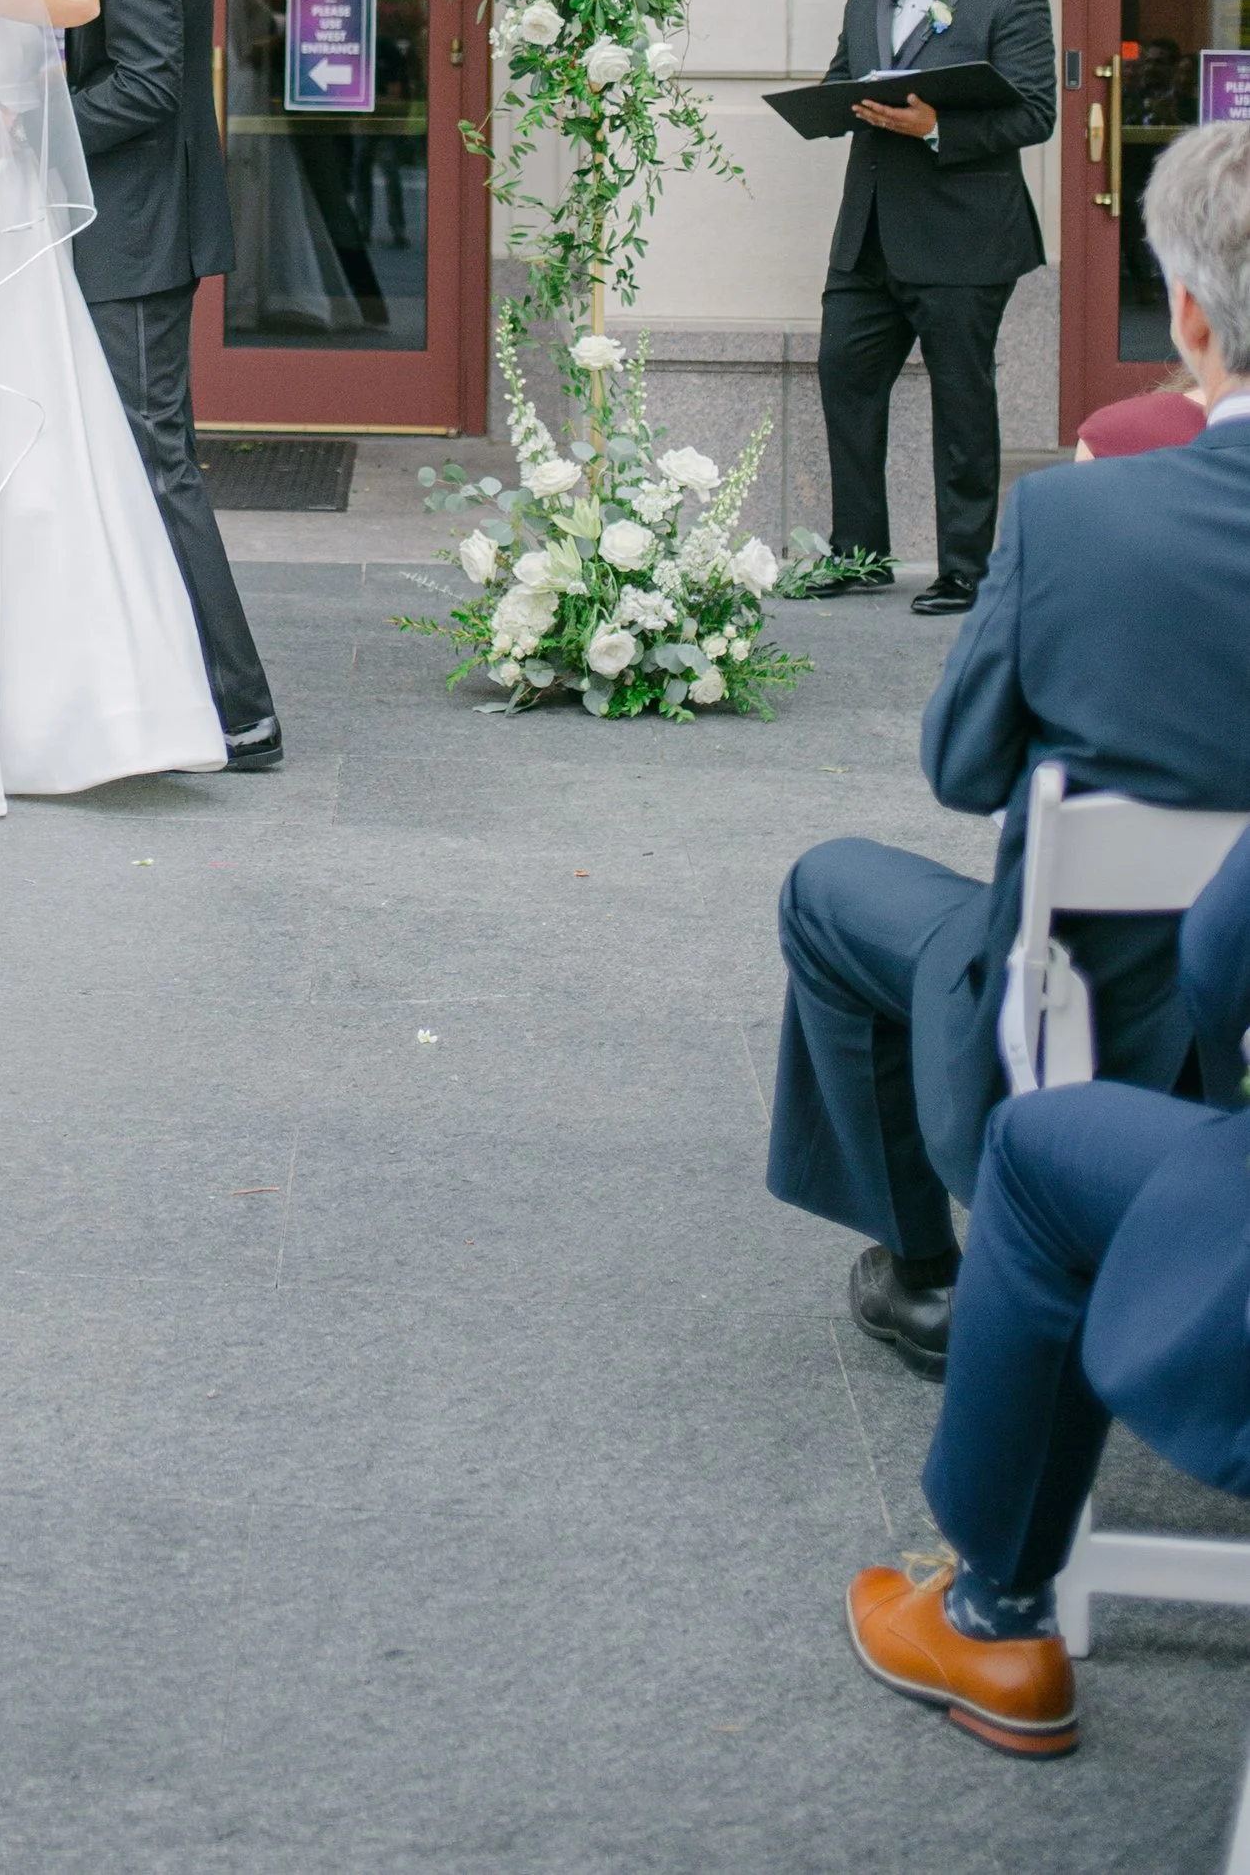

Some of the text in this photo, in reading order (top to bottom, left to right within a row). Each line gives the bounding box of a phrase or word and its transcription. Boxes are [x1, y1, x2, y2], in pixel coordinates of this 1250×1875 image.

[311, 5, 351, 17] PLEASE
[315, 30, 347, 42] WEST
[301, 42, 360, 55] ENTRANCE
